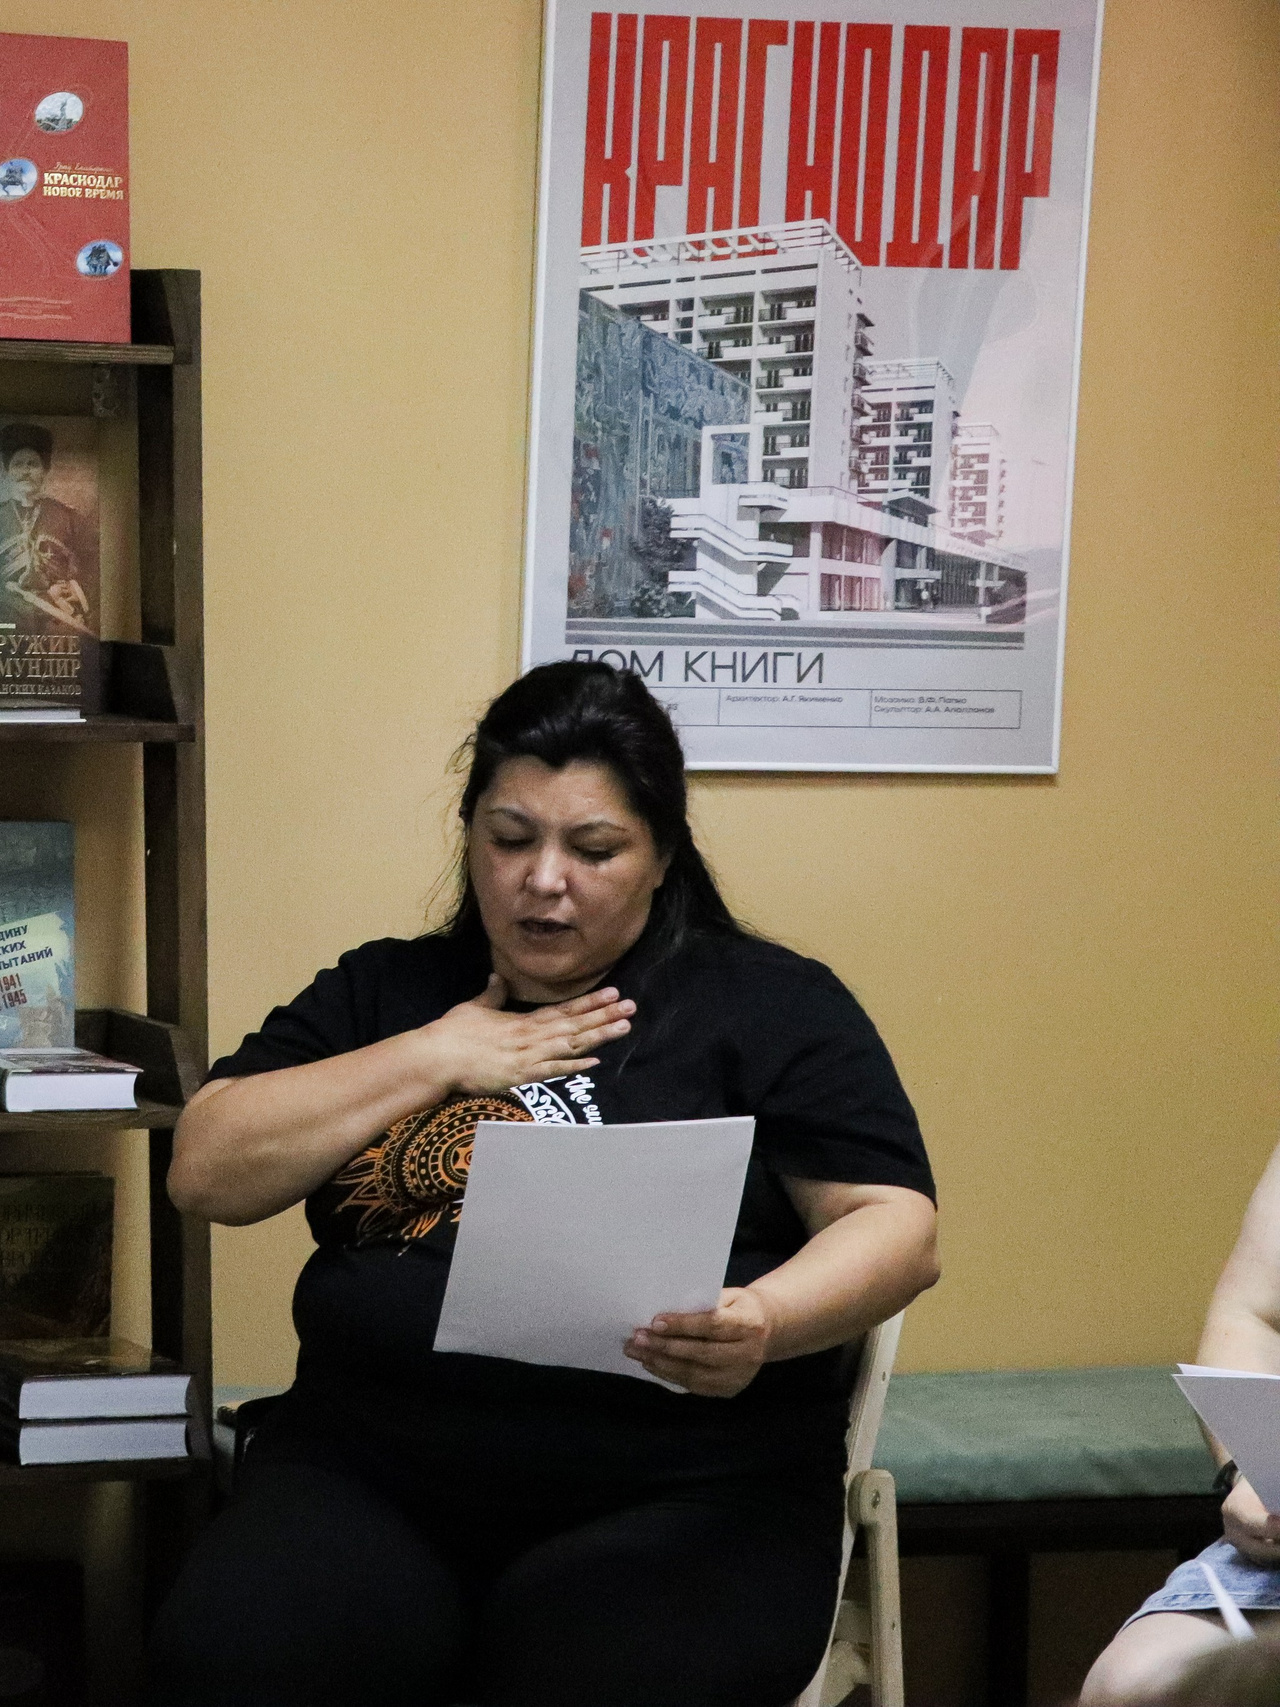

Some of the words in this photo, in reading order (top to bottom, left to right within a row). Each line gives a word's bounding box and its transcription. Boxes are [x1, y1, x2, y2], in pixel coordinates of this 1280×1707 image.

[43, 172, 123, 189] КРАСНОДАР
[42, 186, 82, 198] НОВОЕ
[84, 188, 124, 200] ВРЕМЯ
[683, 650, 825, 684] КНИГИ
[2, 988, 28, 1009] 1945
[564, 1073, 596, 1104] the
